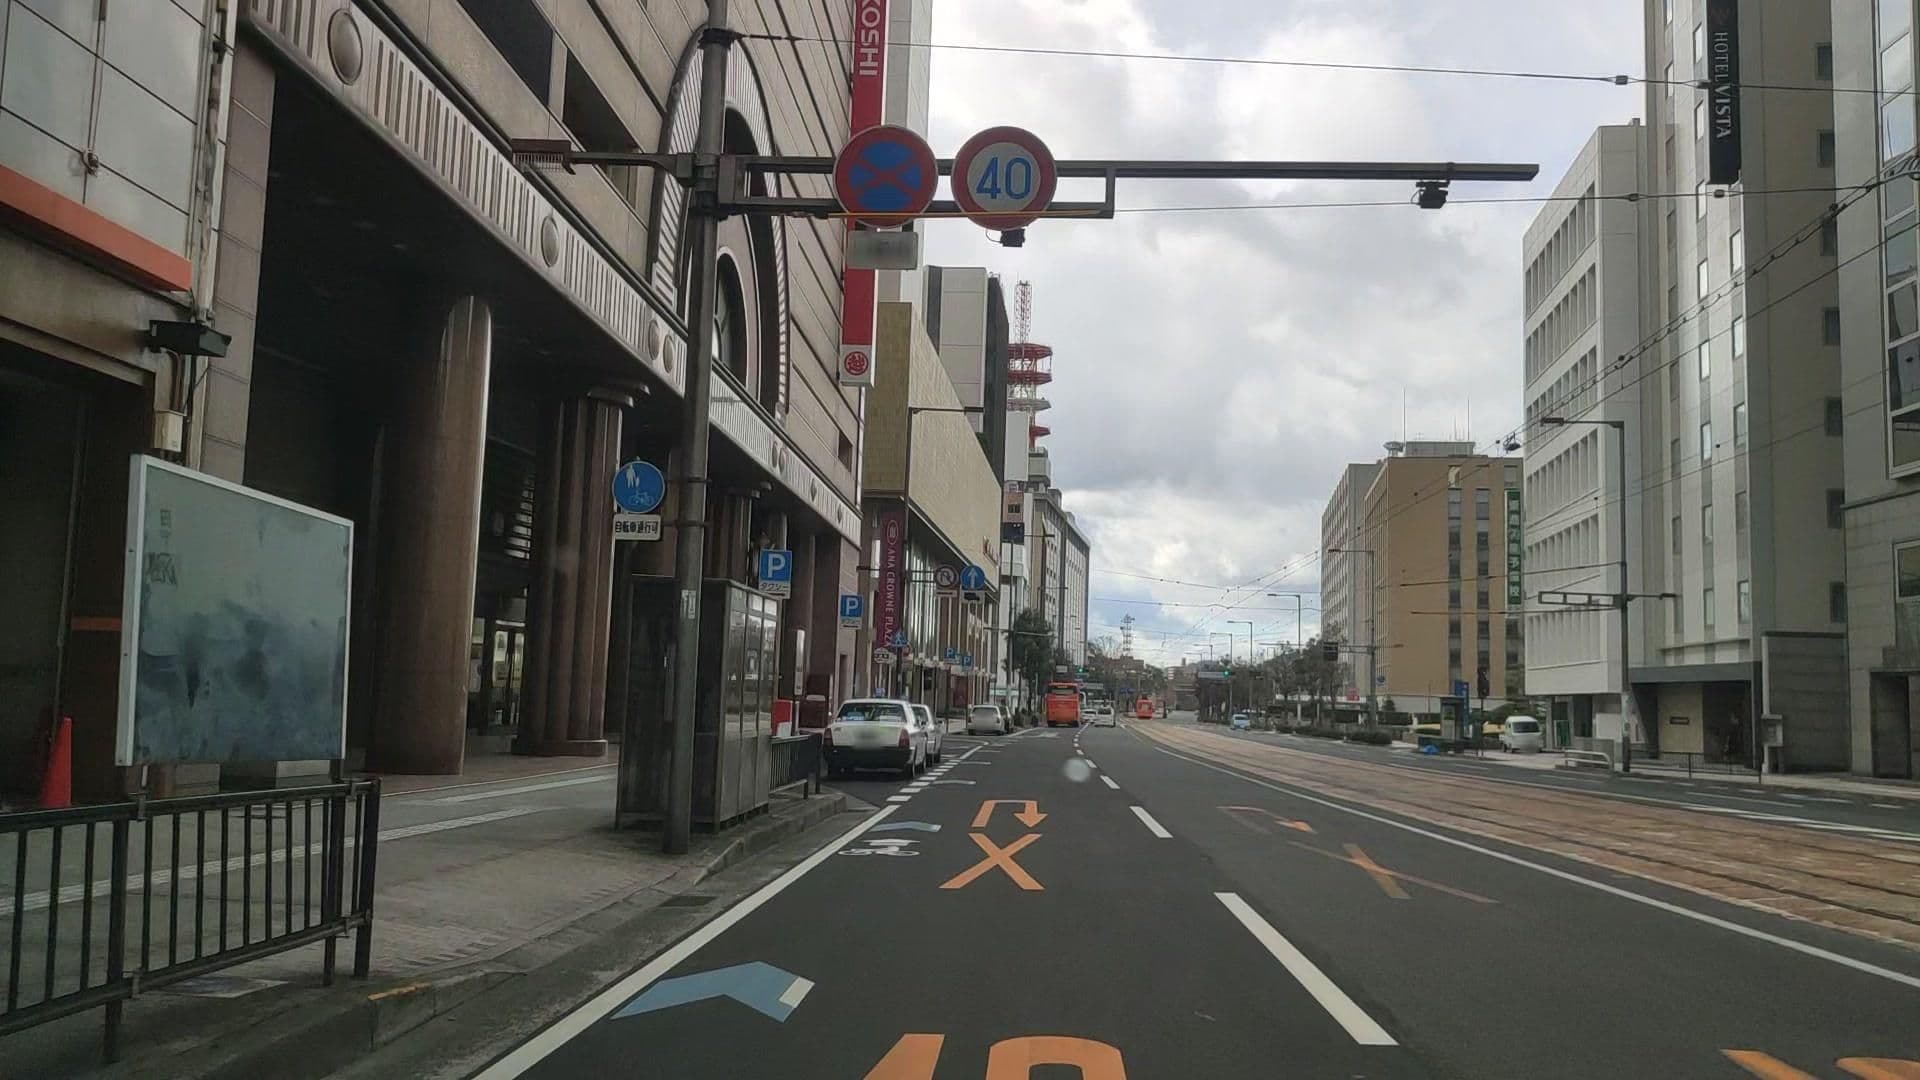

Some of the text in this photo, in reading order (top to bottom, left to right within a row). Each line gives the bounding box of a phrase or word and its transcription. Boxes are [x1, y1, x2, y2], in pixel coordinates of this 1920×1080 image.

[1714, 32, 1731, 138] HOTEL VISTA
[975, 157, 1032, 200] 40
[767, 553, 786, 578] P
[887, 549, 897, 568] ANA
[846, 598, 859, 615] P
[885, 571, 896, 615] CROWNE
